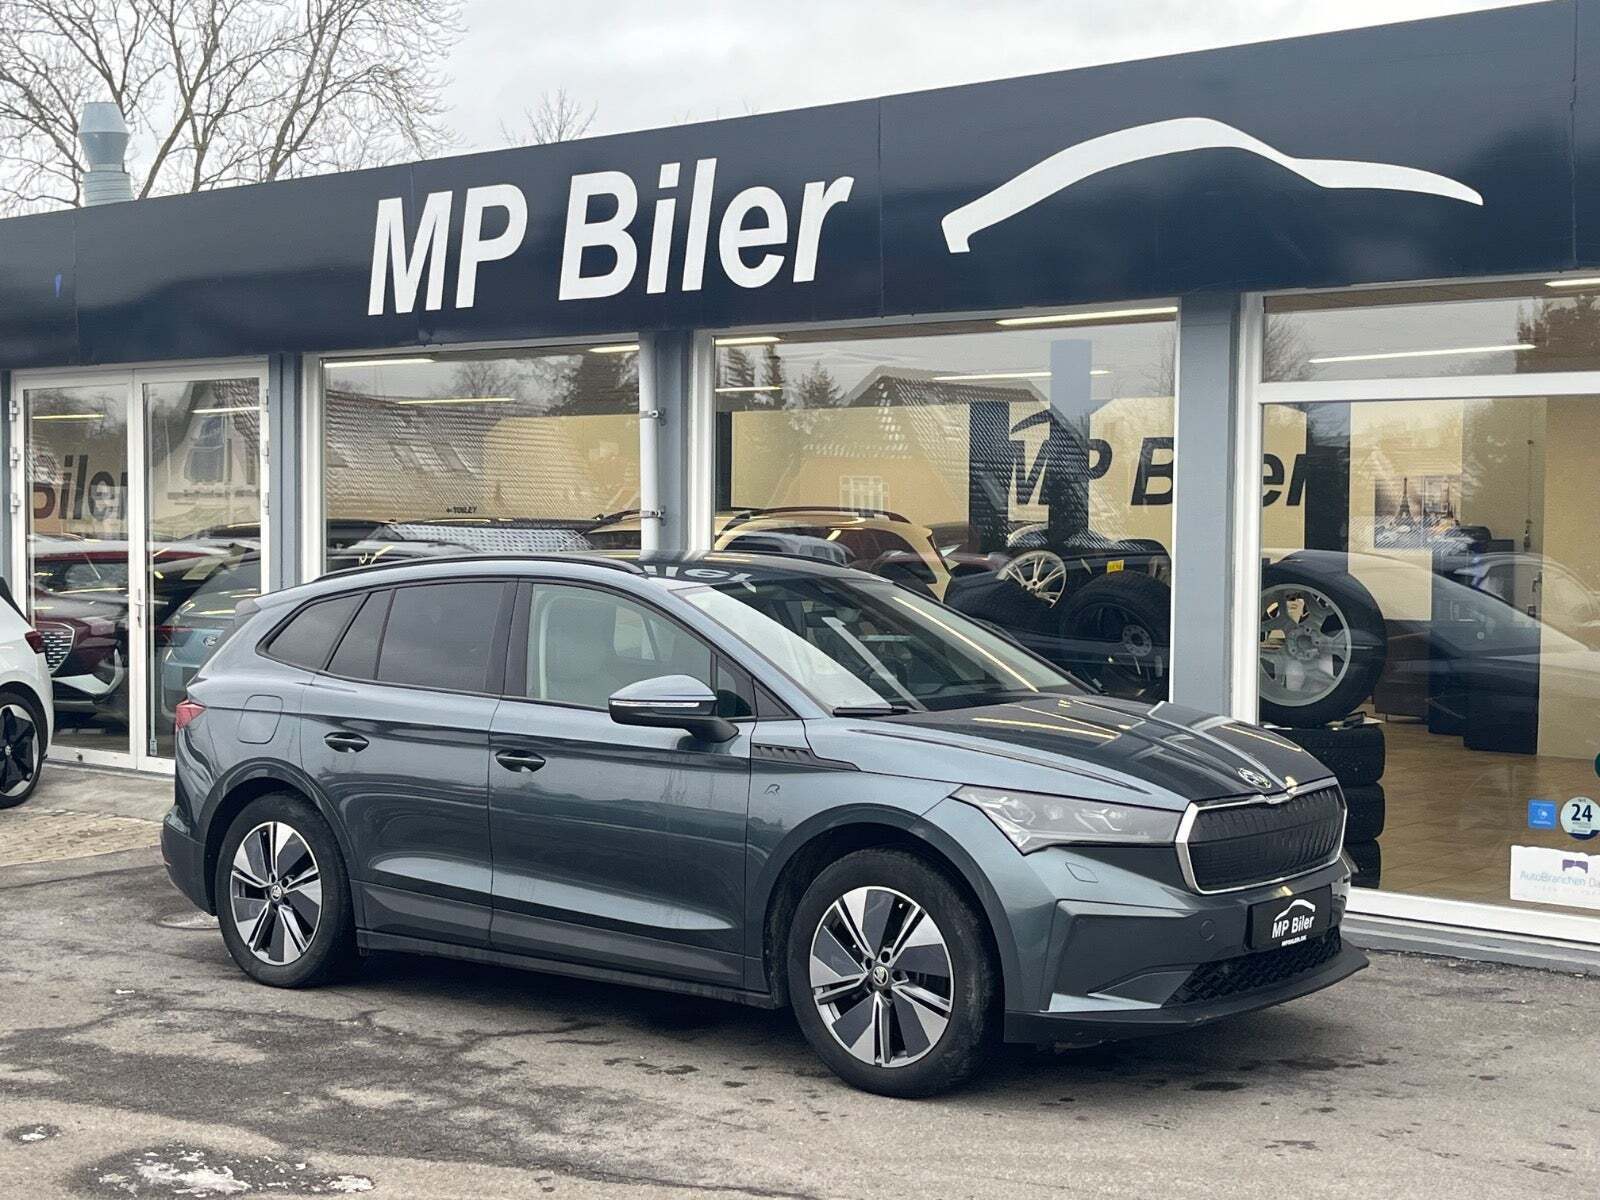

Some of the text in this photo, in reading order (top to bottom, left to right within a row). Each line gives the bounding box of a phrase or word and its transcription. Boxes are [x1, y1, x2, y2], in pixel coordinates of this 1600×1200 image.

[368, 157, 854, 316] MP Biler
[1571, 803, 1593, 822] 24
[1520, 870, 1585, 886] AutoBranchen
[1272, 915, 1314, 938] MP Biler
